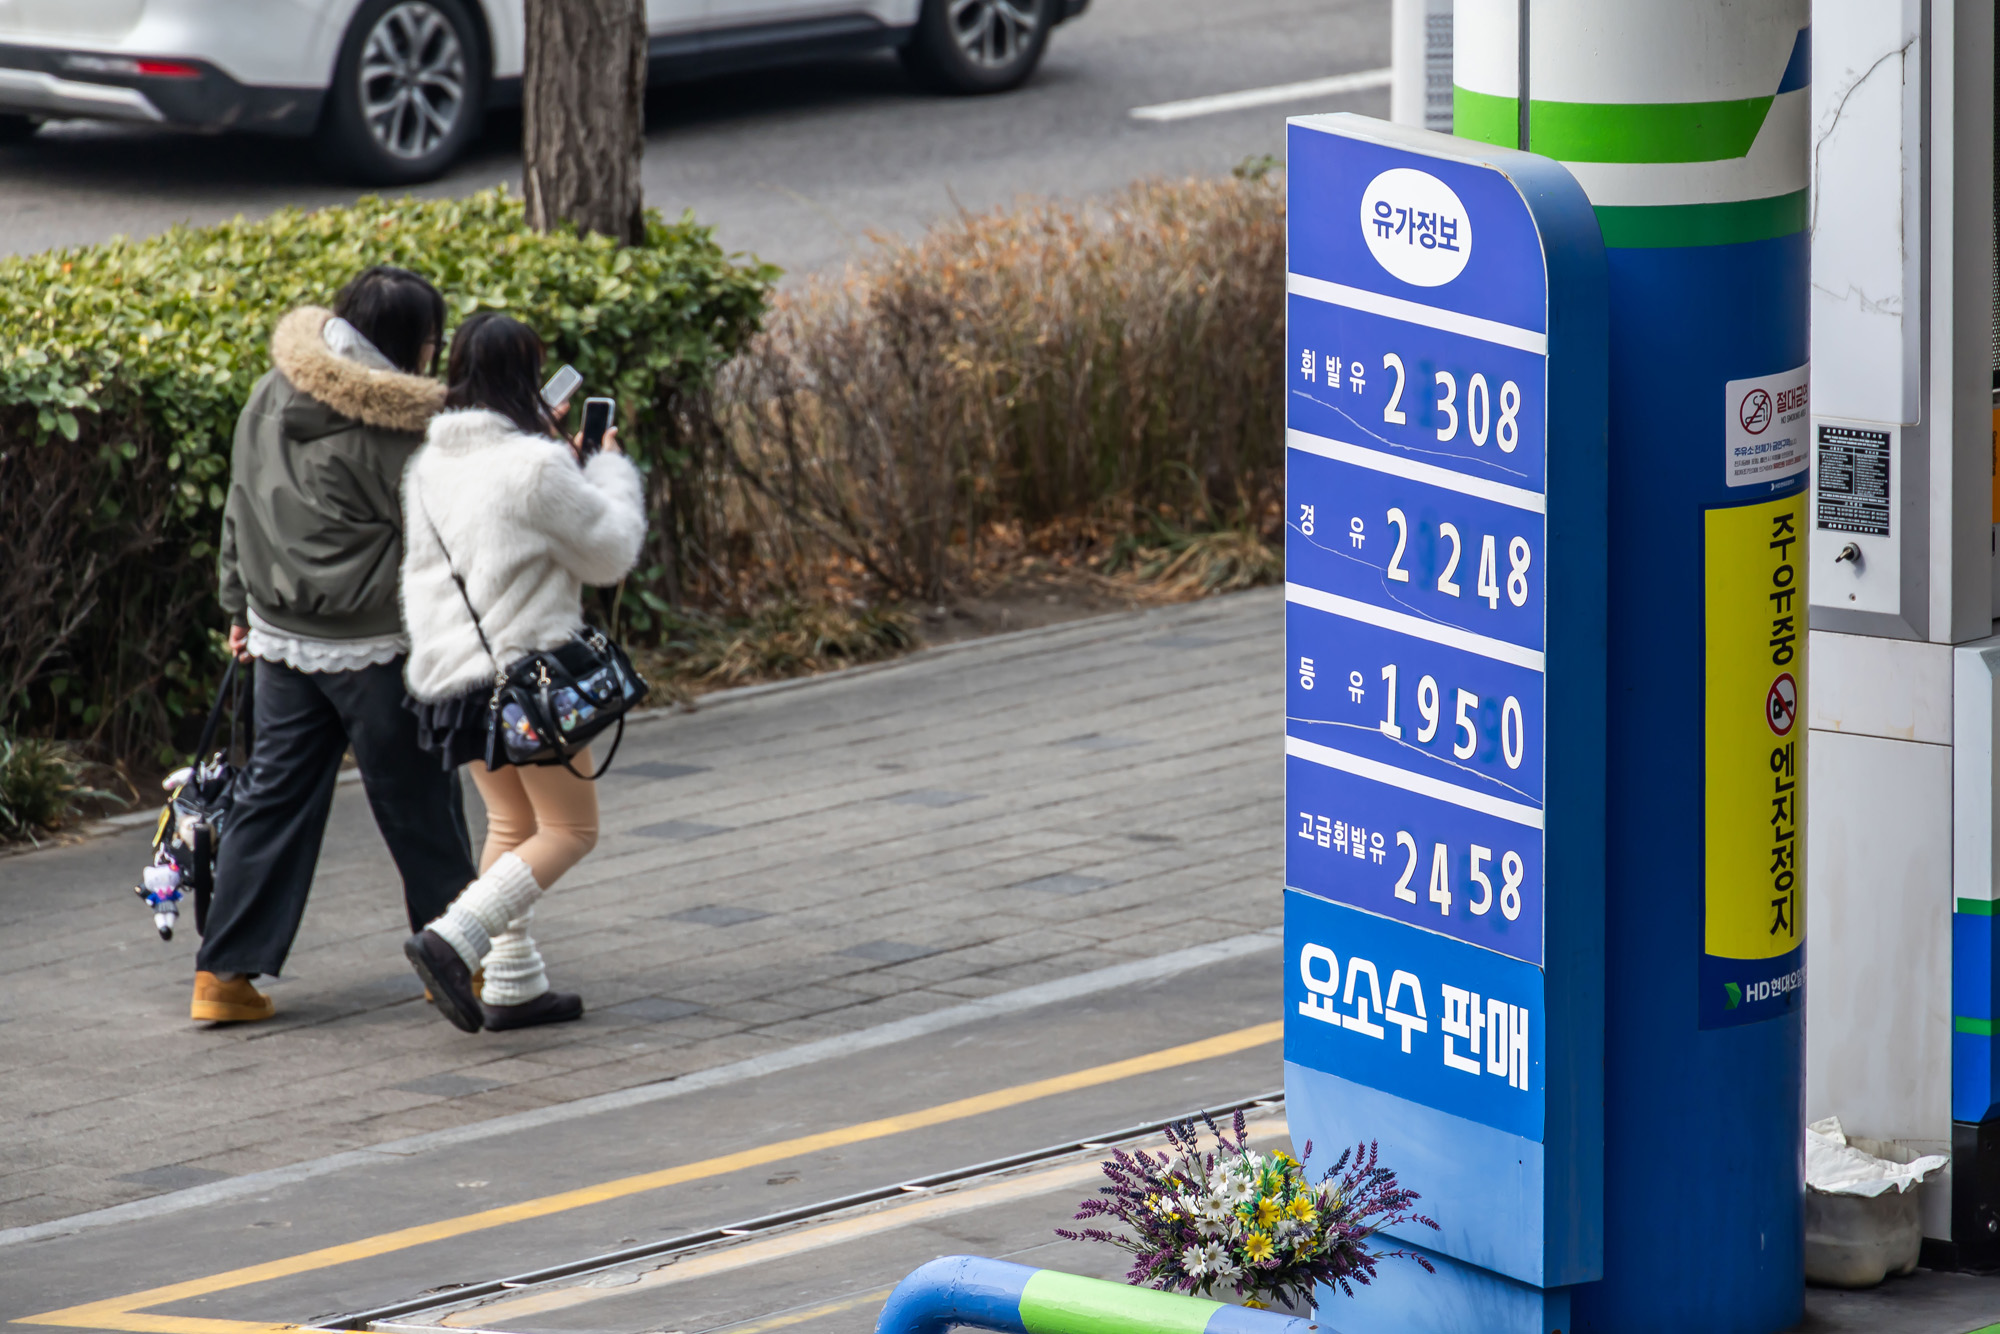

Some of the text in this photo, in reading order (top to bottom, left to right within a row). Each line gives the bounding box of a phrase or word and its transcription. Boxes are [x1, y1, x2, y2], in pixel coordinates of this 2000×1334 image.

[1373, 200, 1460, 253] 유가정보
[1301, 349, 1522, 454] 휘발유 2308
[1734, 446, 1755, 457] 주유소
[1386, 507, 1531, 611] 2248
[1769, 512, 1796, 666] 주유중
[1380, 664, 1524, 770] 1950
[1298, 812, 1524, 921] 고급휘발유 2458
[1769, 741, 1795, 938] 엔진정지
[1298, 942, 1529, 1092] 요소수 판매
